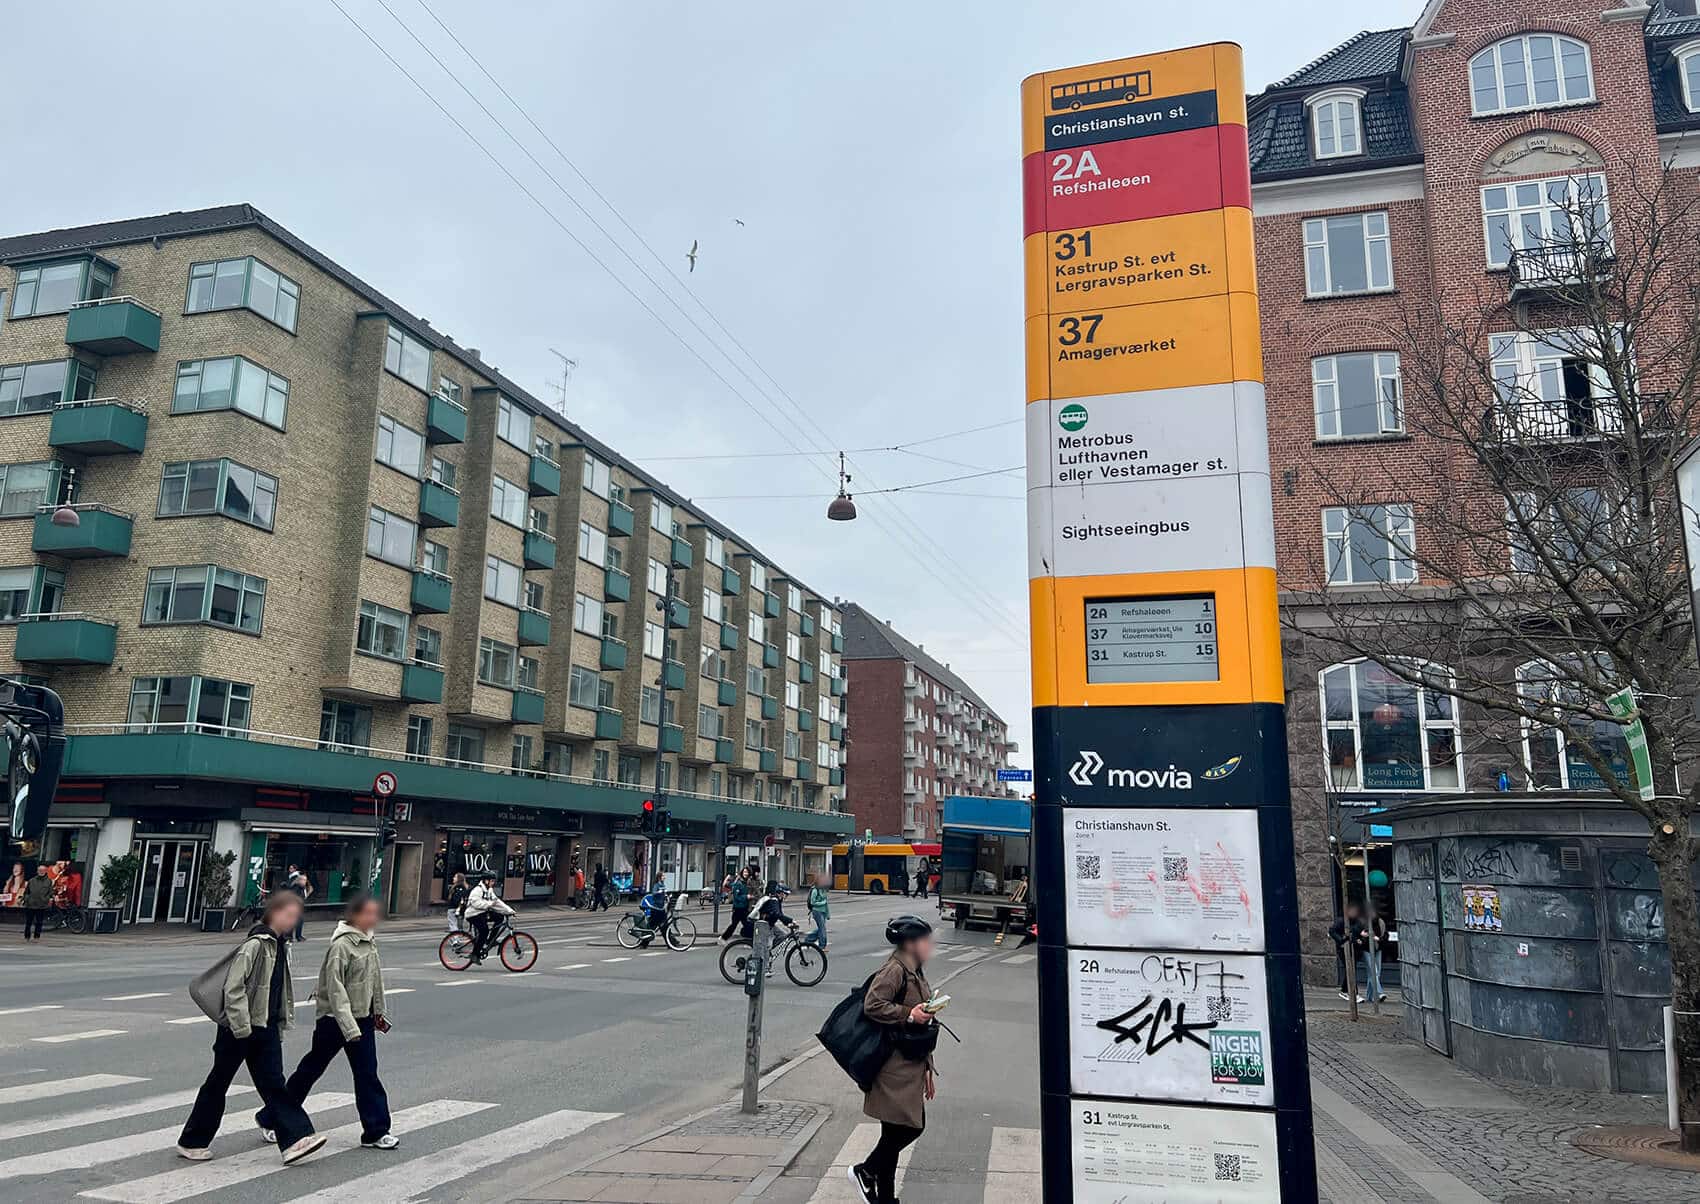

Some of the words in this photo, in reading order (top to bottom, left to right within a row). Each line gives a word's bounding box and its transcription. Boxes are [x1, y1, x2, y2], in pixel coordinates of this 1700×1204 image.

[1051, 109, 1163, 137] Christianshavn
[1168, 106, 1189, 119] st.
[1052, 150, 1101, 182] 2A
[1053, 173, 1151, 197] Refshaleøen
[1055, 230, 1092, 261] 31
[1055, 259, 1118, 277] Kastrup
[1123, 255, 1145, 268] St.
[1151, 250, 1176, 265] evt
[1055, 267, 1184, 293] Lergravsparken
[1189, 263, 1211, 276] St.
[1057, 314, 1104, 347] 37
[1057, 338, 1177, 362] Amagerværket
[1058, 432, 1134, 449] Metrobus
[1058, 449, 1149, 466] Lufthavnen
[1059, 468, 1094, 482] eller
[1100, 460, 1199, 478] Vestamager
[1206, 458, 1228, 471] st.
[1062, 520, 1190, 541] Sightseeingbus
[1090, 608, 1107, 619] 2A
[1202, 601, 1211, 612] 1
[1091, 628, 1107, 640] 37
[1194, 622, 1212, 634] 10
[1091, 649, 1109, 661] 31
[1123, 650, 1154, 659] Kastrup
[1195, 644, 1214, 656] 15
[1107, 764, 1192, 790] movia
[1367, 767, 1392, 777] Long
[1075, 820, 1154, 831] Christianshavn
[1156, 821, 1172, 831] St.
[1079, 960, 1100, 973] 2A
[1211, 1035, 1260, 1053] INGEN
[1213, 1064, 1235, 1076] FOR
[1083, 1110, 1103, 1125] 31
